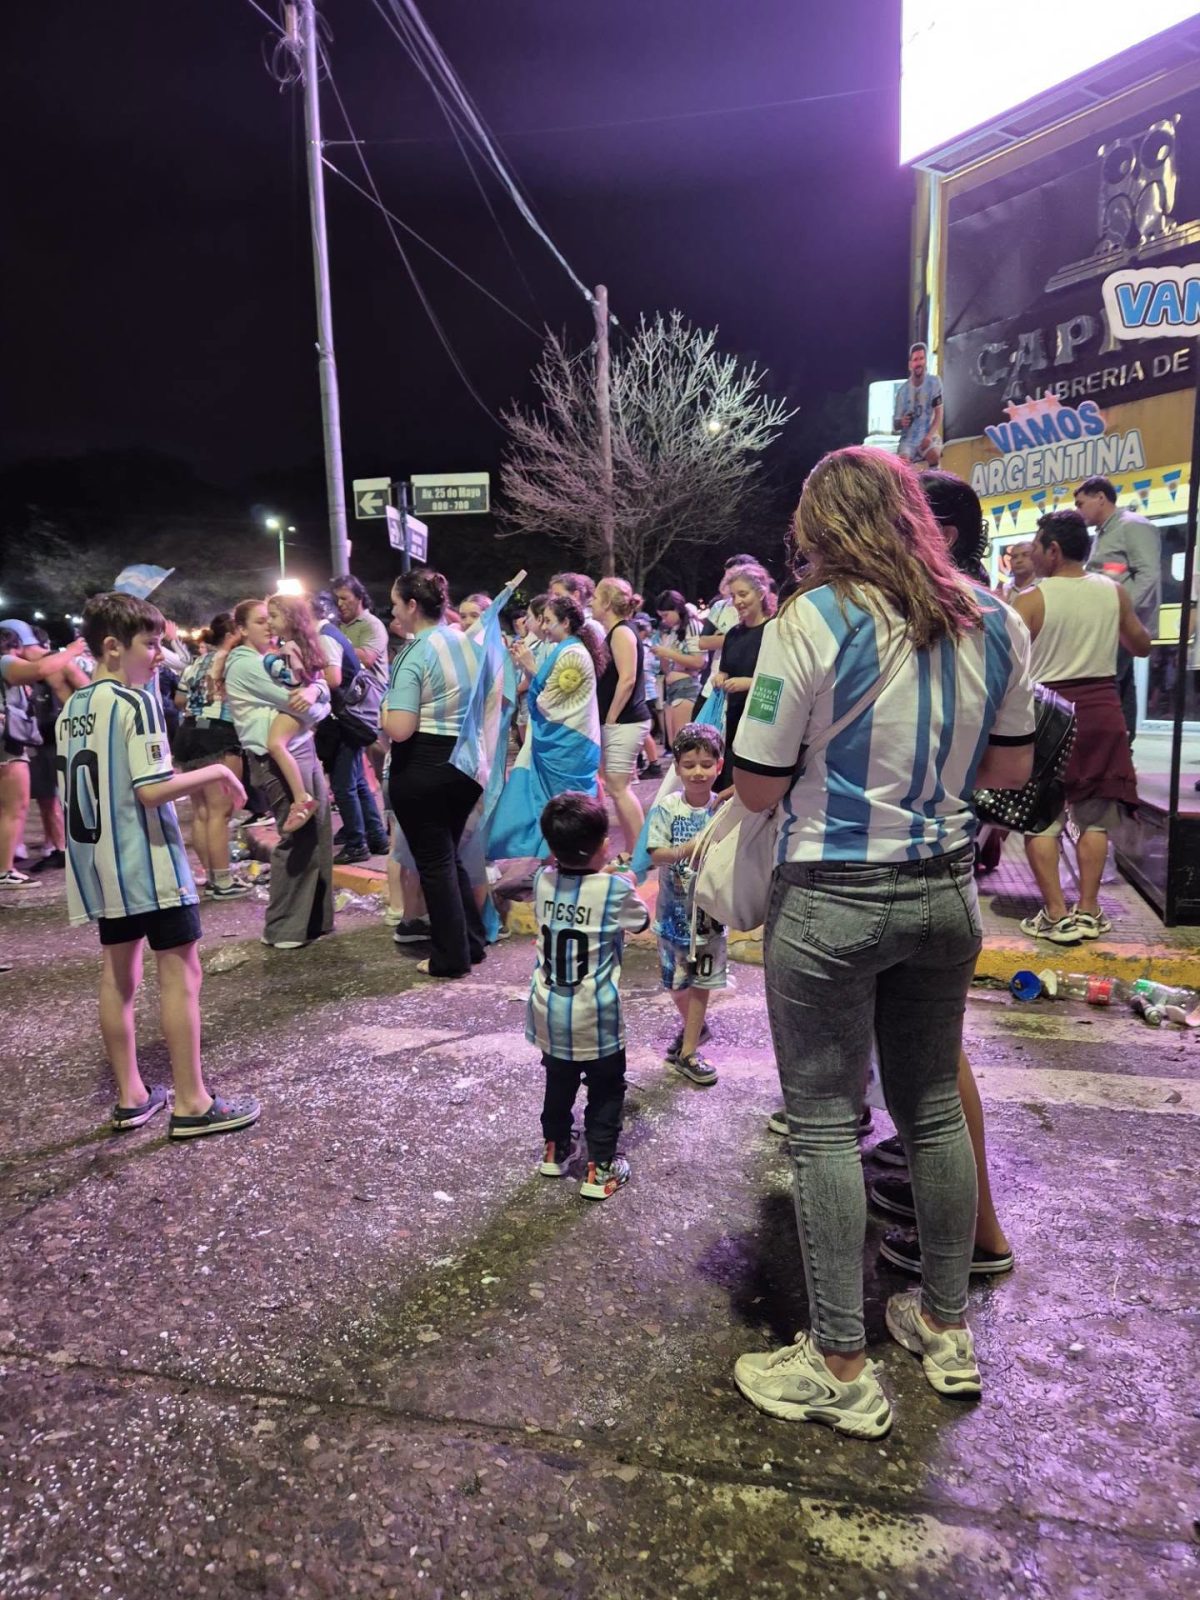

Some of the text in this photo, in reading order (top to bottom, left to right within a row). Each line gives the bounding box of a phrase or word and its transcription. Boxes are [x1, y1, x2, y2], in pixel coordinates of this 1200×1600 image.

[1152, 348, 1191, 377] DE
[985, 402, 1105, 454] VAMOS
[971, 430, 1146, 497] ARGENTINA
[434, 487, 446, 499] 25
[60, 713, 96, 741] MESSI
[543, 900, 592, 926] MESSI
[541, 924, 589, 987] 10
